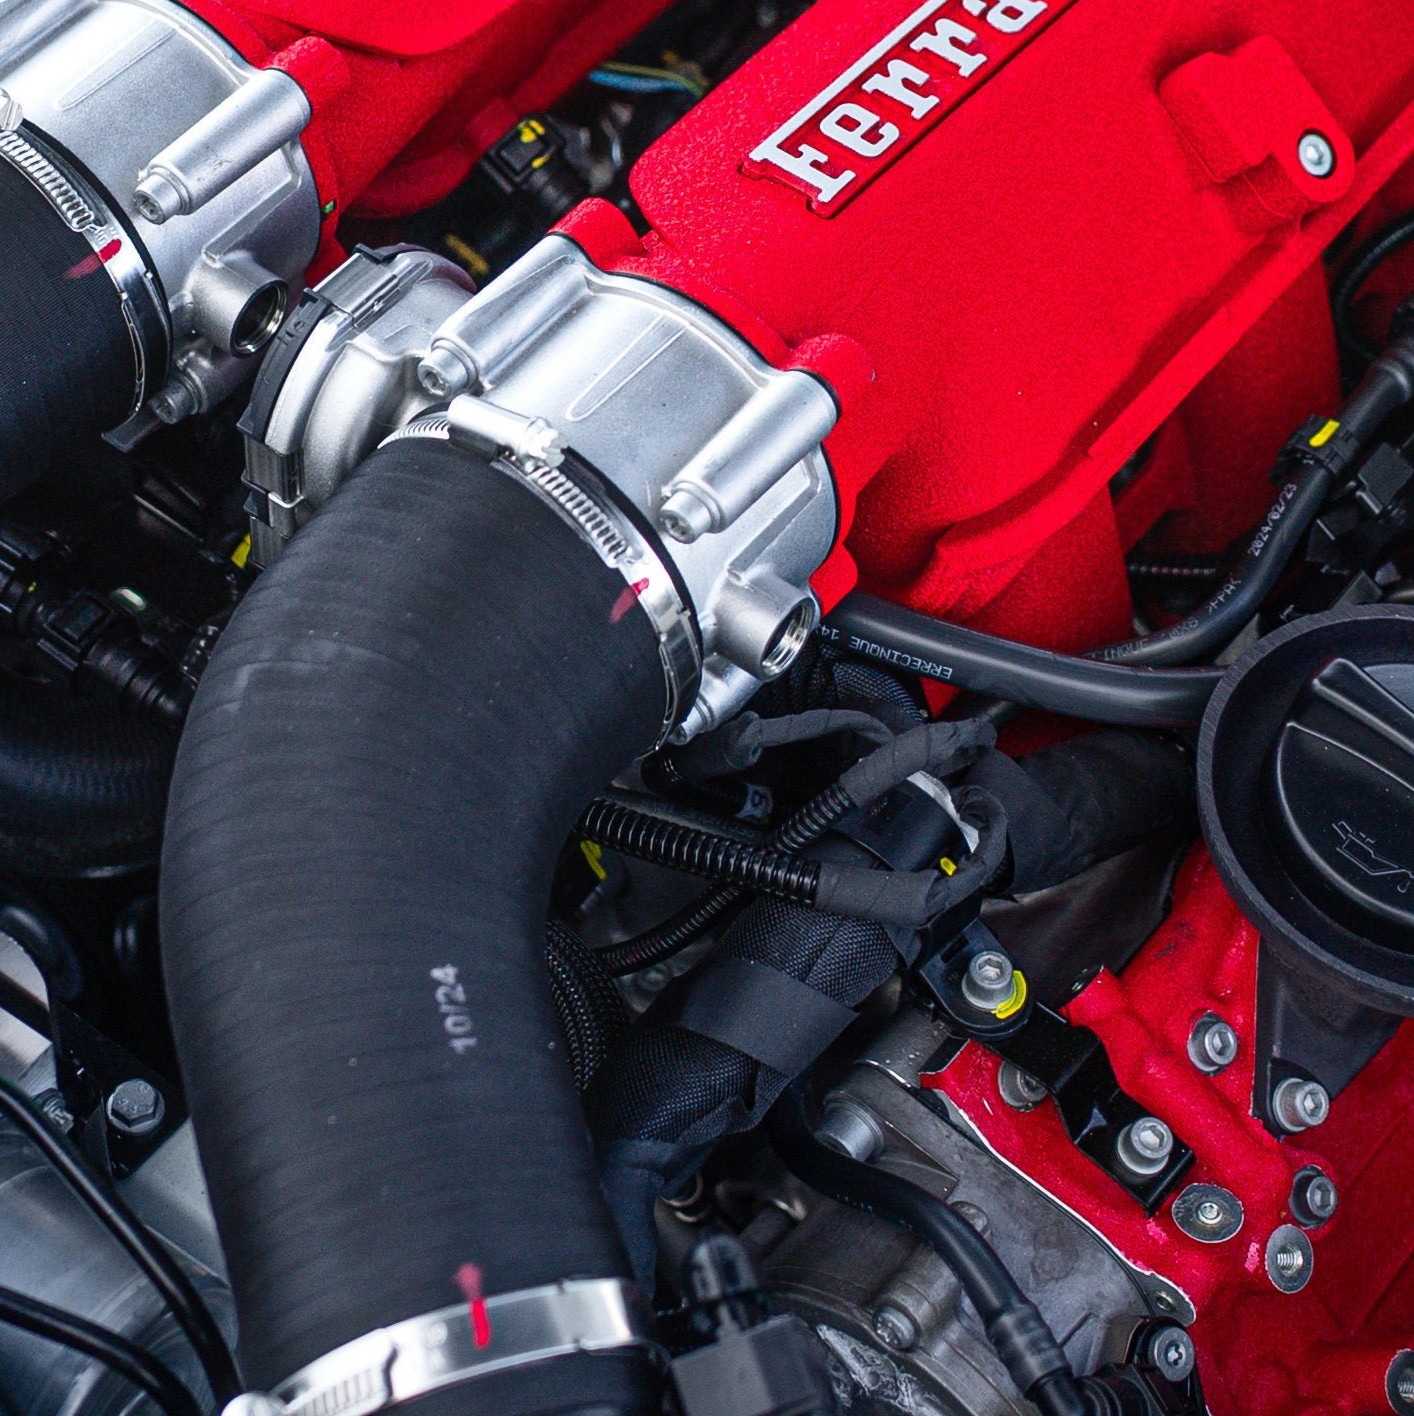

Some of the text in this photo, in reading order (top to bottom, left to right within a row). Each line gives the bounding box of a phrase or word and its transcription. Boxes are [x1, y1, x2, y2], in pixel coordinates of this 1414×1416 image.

[1248, 483, 1298, 557] 2024/02/23
[848, 635, 953, 680] ERRECINQUE
[429, 963, 476, 1055] 10/24
